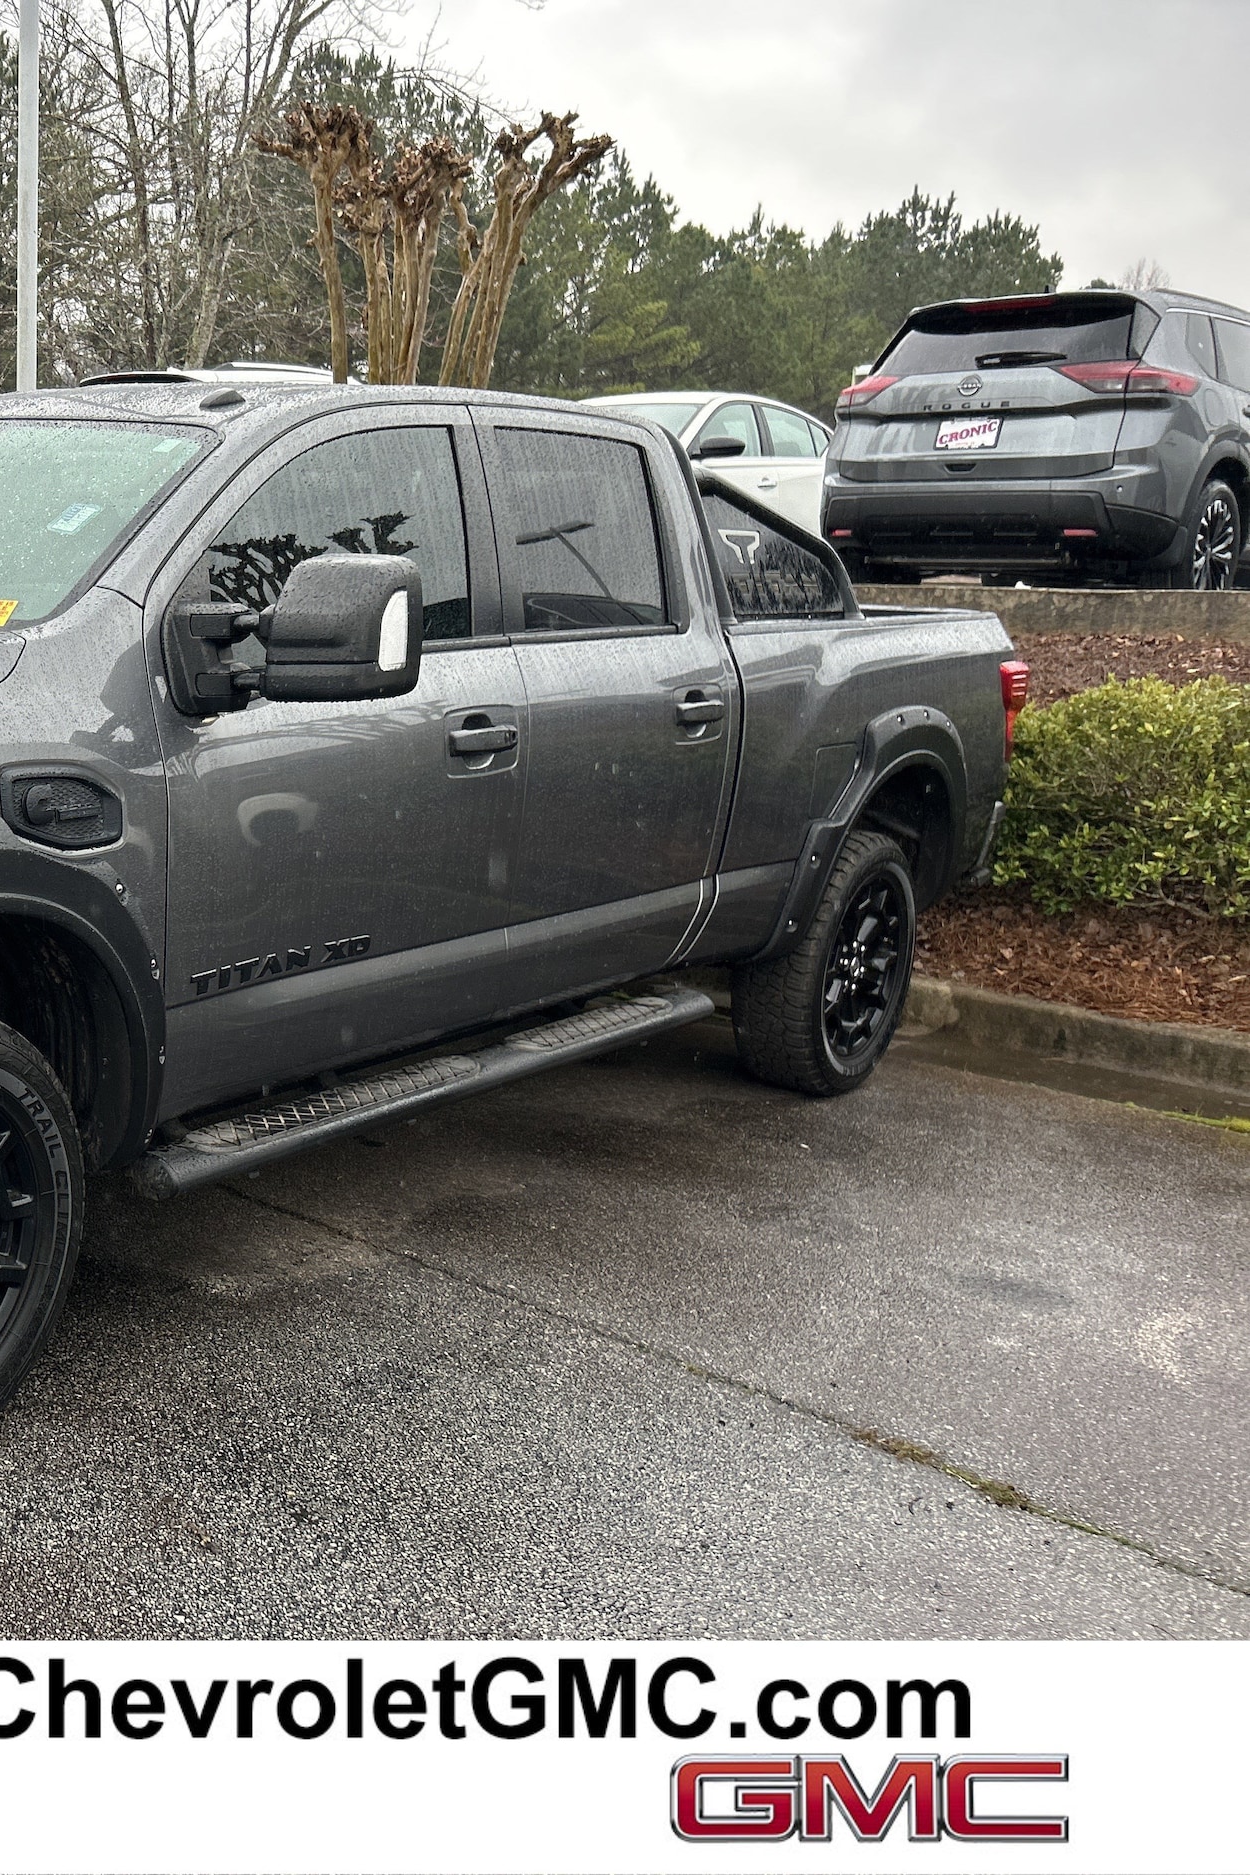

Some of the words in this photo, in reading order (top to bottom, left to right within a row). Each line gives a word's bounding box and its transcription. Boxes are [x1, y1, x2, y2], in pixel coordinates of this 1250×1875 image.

[923, 401, 1010, 411] ROGUE
[939, 422, 997, 444] CRONIC
[190, 945, 312, 996] TITAN
[320, 934, 371, 963] XD
[18, 1087, 62, 1159] TRAIL
